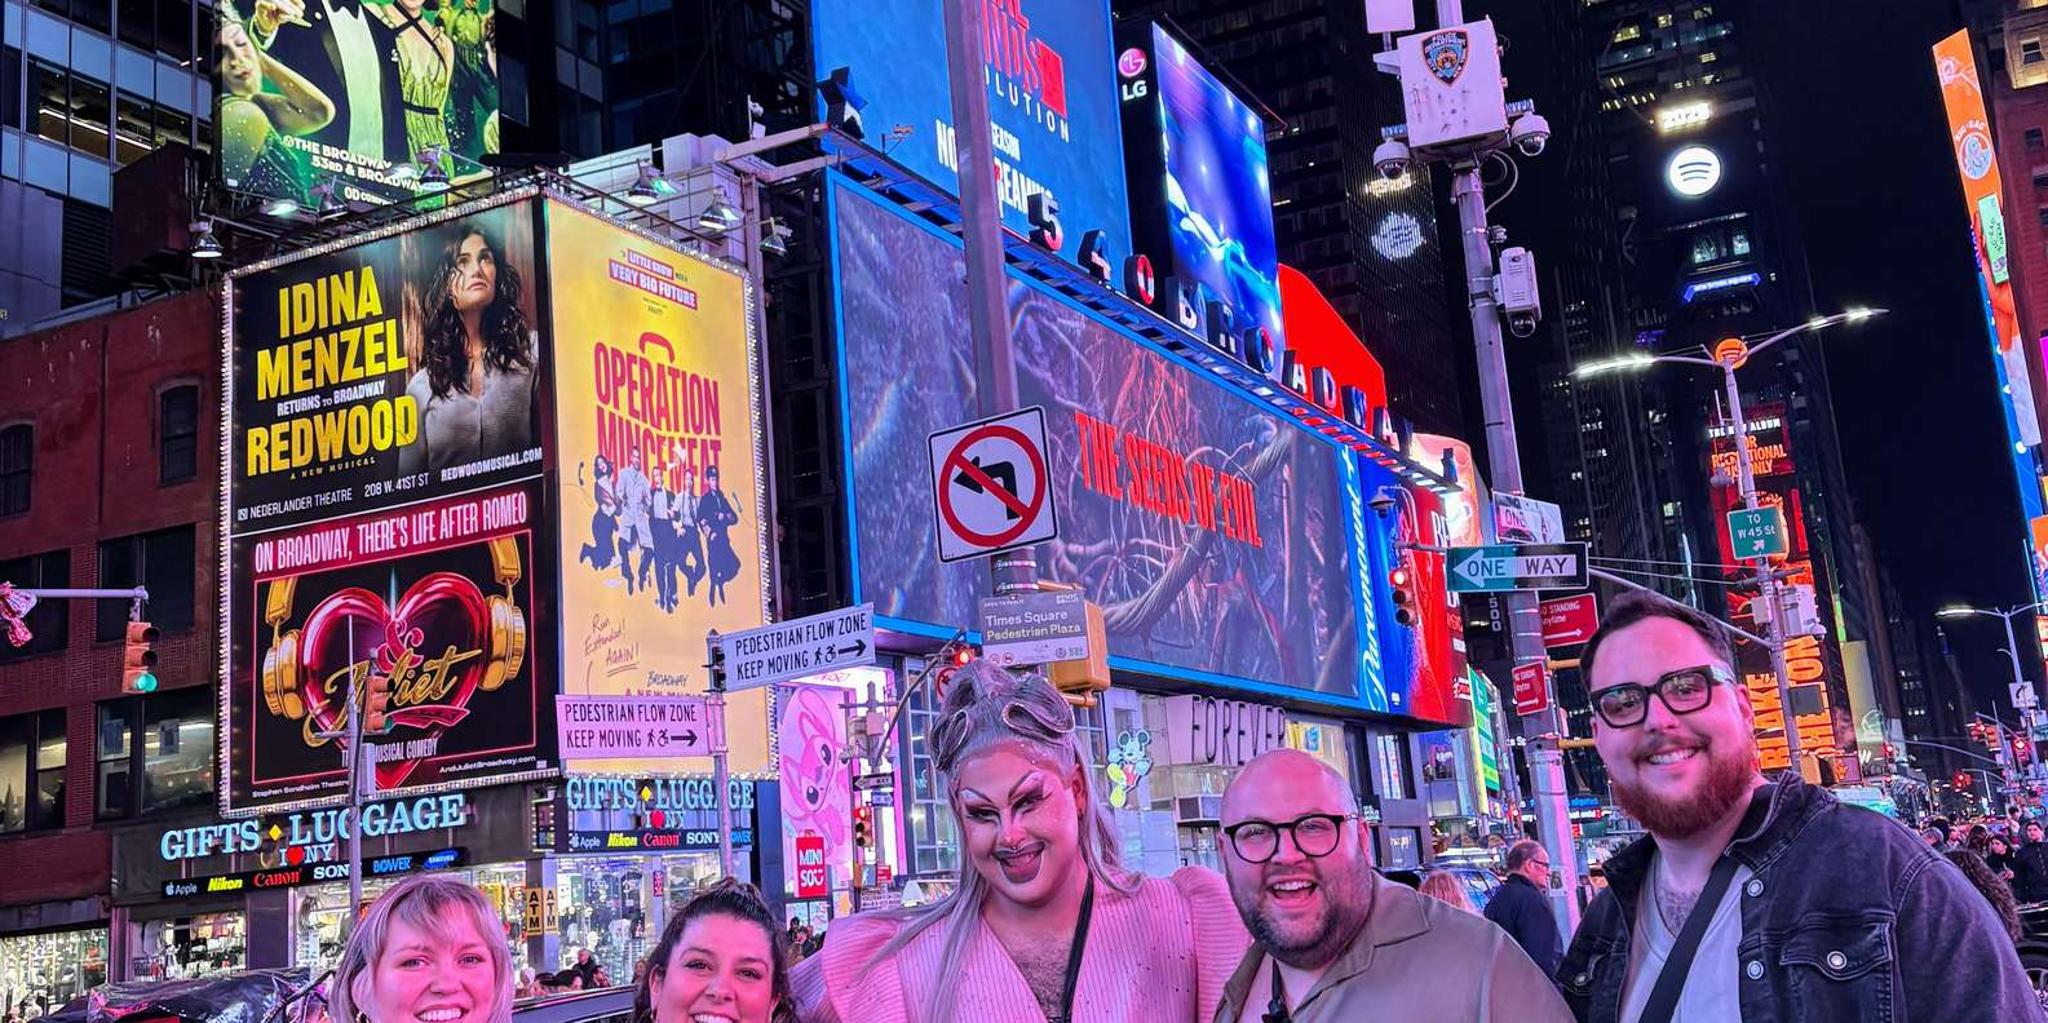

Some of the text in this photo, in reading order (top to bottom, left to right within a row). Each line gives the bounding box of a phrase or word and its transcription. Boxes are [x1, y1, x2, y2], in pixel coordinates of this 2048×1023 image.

[1122, 80, 1147, 101] LG
[294, 137, 392, 169] THE BROADWAY
[345, 163, 356, 177] &
[611, 261, 639, 285] VERY
[640, 272, 658, 294] BIG
[659, 280, 696, 308] FUTURE
[279, 265, 383, 338] IDINA
[257, 319, 408, 401] MENZEL
[277, 391, 321, 416] RETURNS
[334, 379, 386, 405] BROADWAY
[594, 341, 722, 436] OPERATION
[247, 394, 419, 477] REDWOOD
[1750, 418, 1781, 431] ALBUM
[290, 457, 376, 481] A NEW MUSICAL
[441, 447, 543, 482] REDWOODMUSICAL.COM
[364, 473, 429, 498] 208 W. 41ST ST
[1075, 410, 1263, 549] THE SEEDS OF EVIL
[249, 488, 352, 520] NEDERLANDER THEATRE
[255, 491, 526, 573] ON BROADWAY, THERE'S LIFE AFTER ROMEO
[1737, 525, 1775, 539] W 45 St
[1747, 514, 1761, 525] TO
[1467, 557, 1568, 577] ONE WAY
[592, 613, 611, 634] Run
[985, 611, 1068, 627] Times Square
[735, 612, 867, 657] PEDESTRIAN FLOW ZONE
[987, 623, 1081, 641] Pedestrian Plaza
[605, 642, 639, 667] AGAIN!
[736, 650, 809, 681] KEEP MOVING
[647, 671, 689, 687] BROADWAY
[565, 704, 697, 722] PEDESTRIAN FLOW ZONE
[407, 738, 438, 759] COMEDY
[566, 729, 642, 749] KEEP MOVING
[439, 755, 536, 774] AndJulietBroadway.com
[252, 788, 283, 799] Stephen
[284, 783, 320, 795] Sondheim
[566, 778, 754, 810] GIFTS LUGGGE
[160, 819, 262, 861] GIFTS
[580, 836, 600, 849] Apple
[607, 833, 637, 848] Nikon
[642, 833, 681, 847] Canon
[305, 844, 333, 863] NY
[799, 849, 824, 866] MINI
[174, 882, 198, 896] Apple
[207, 876, 244, 893] Nikon
[252, 870, 300, 887] Canon
[313, 864, 349, 880] SON
[373, 856, 411, 873] BOWER
[529, 890, 540, 928] ATM
[546, 889, 555, 926] ATM
